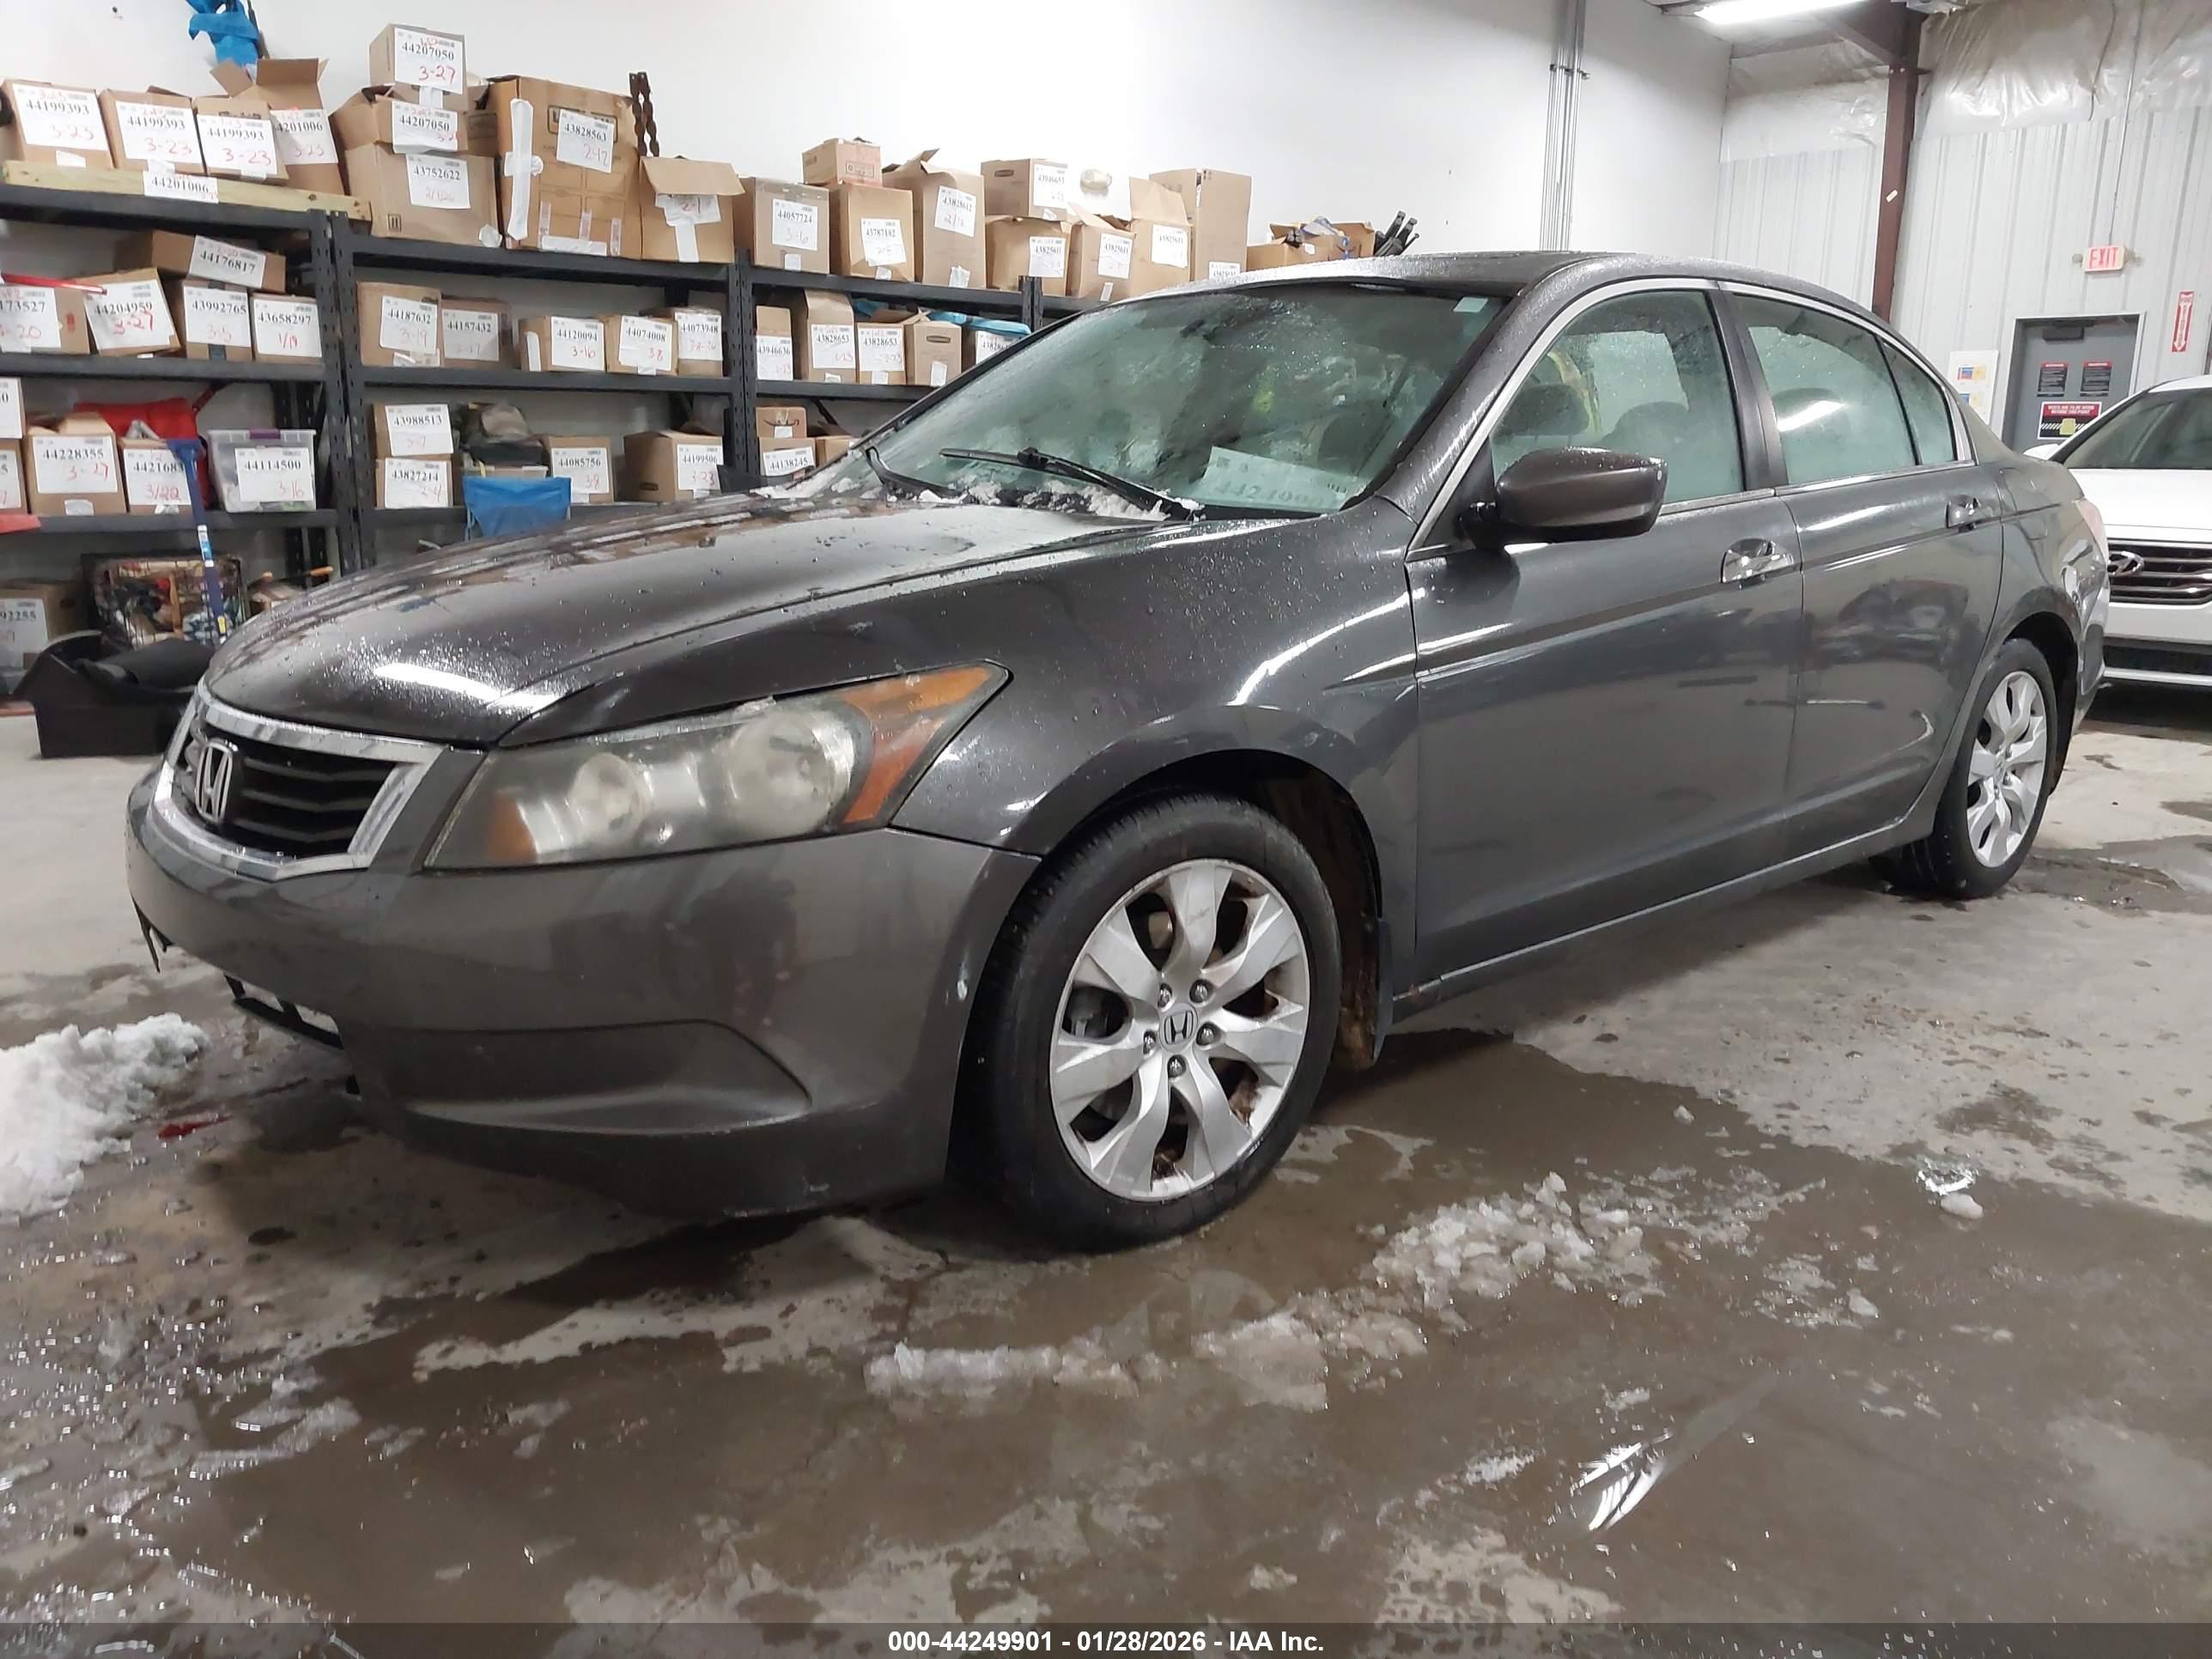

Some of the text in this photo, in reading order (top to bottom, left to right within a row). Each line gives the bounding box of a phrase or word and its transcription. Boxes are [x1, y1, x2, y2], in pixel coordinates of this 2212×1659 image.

[402, 41, 454, 61] 44207050
[419, 65, 456, 84] 3-27
[26, 100, 89, 115] 44199393
[128, 116, 185, 131] 44199393
[399, 114, 450, 131] 44207050
[207, 128, 264, 142] 44199393
[564, 123, 607, 143] 43828563
[222, 148, 272, 166] 3-23
[414, 165, 460, 180] 43752622
[151, 176, 209, 193] 44201006
[777, 210, 812, 223] 44057724
[200, 250, 256, 275] 44176817
[2088, 247, 2119, 269] EXIT
[94, 302, 153, 315] 44204959
[192, 301, 246, 315] 43992765
[258, 313, 311, 325] 43658297
[388, 308, 431, 325] 44187632
[447, 320, 491, 332] 44157432
[557, 326, 598, 342] 44120094
[626, 327, 665, 343] 44074008
[817, 334, 850, 343] 43828653
[864, 337, 898, 346] 43828653
[394, 415, 442, 426] 43988513
[43, 449, 104, 460] 44228355
[559, 456, 601, 468] 44085756
[245, 459, 301, 471] 44114500
